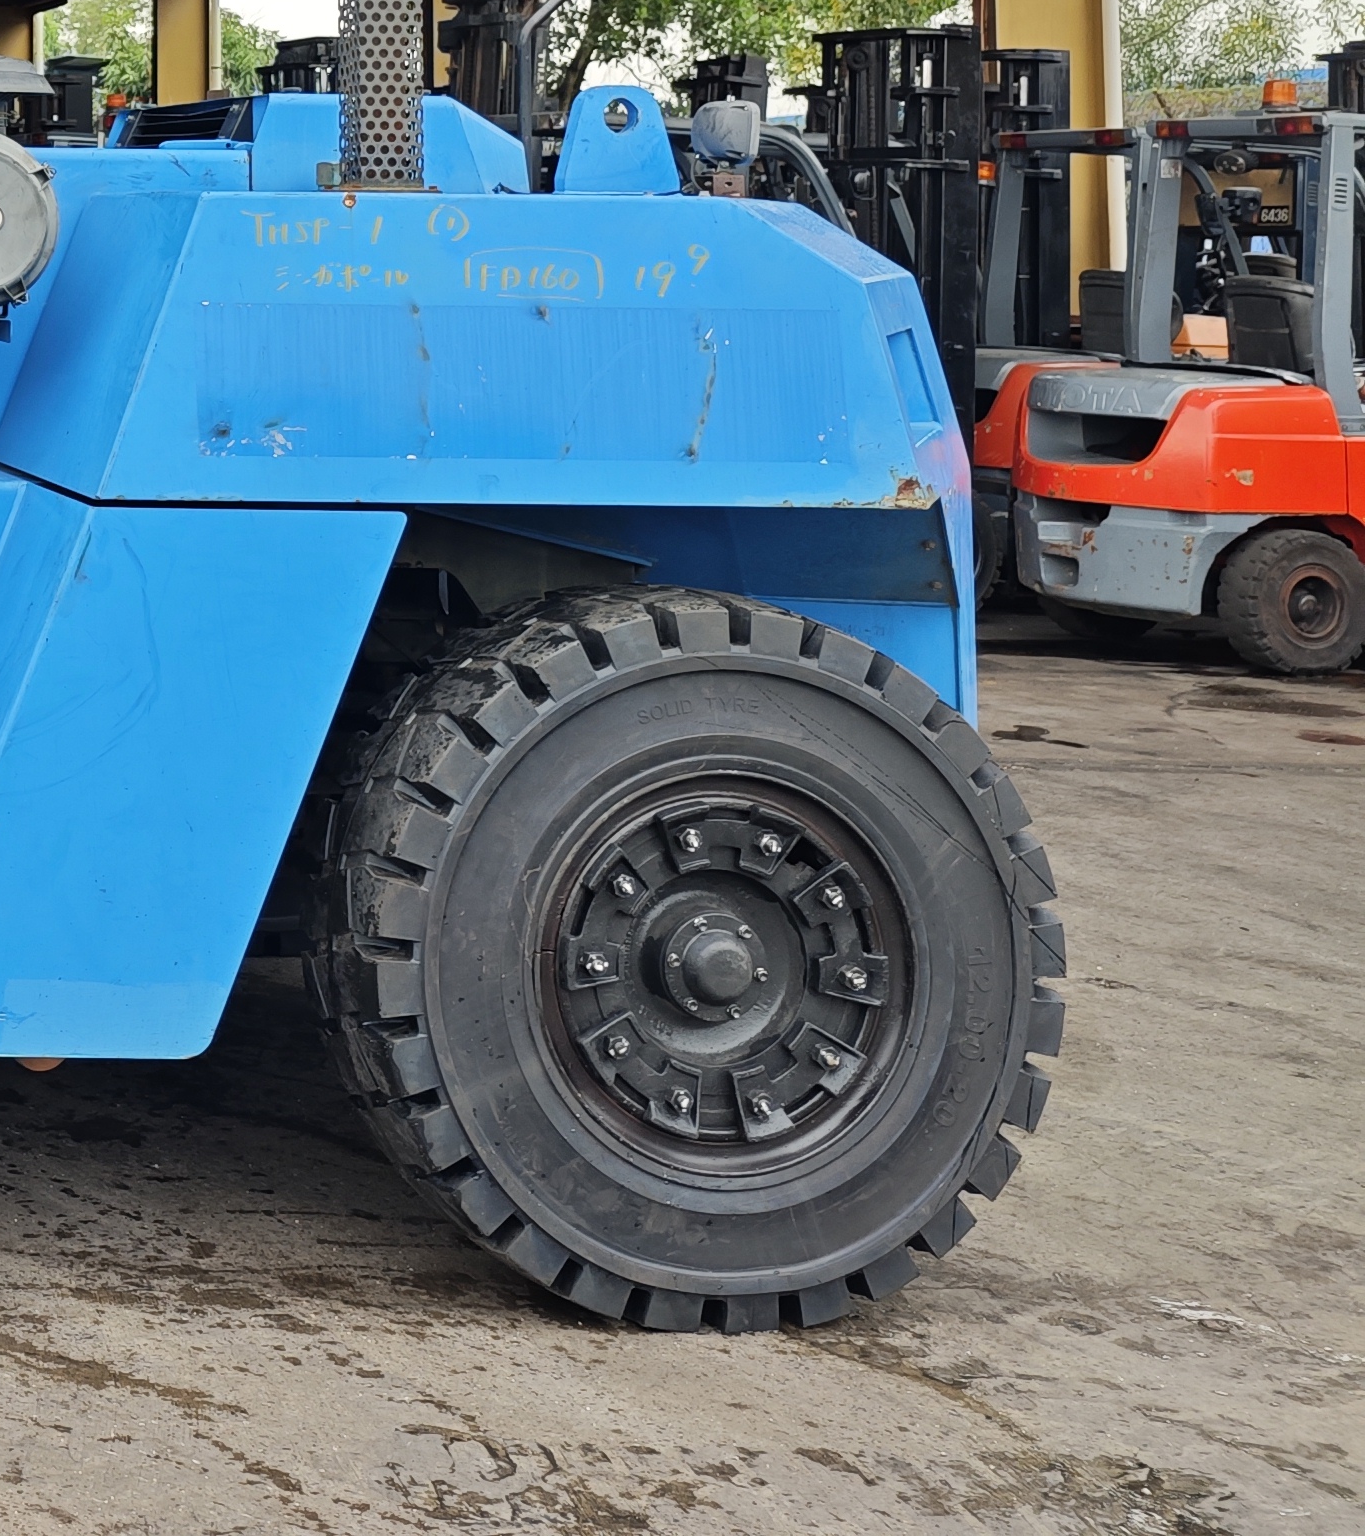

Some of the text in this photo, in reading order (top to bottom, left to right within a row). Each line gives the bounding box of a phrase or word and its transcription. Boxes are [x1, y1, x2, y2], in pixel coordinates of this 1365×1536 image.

[1260, 207, 1288, 223] 6436
[636, 696, 760, 725] SOLID TYRE
